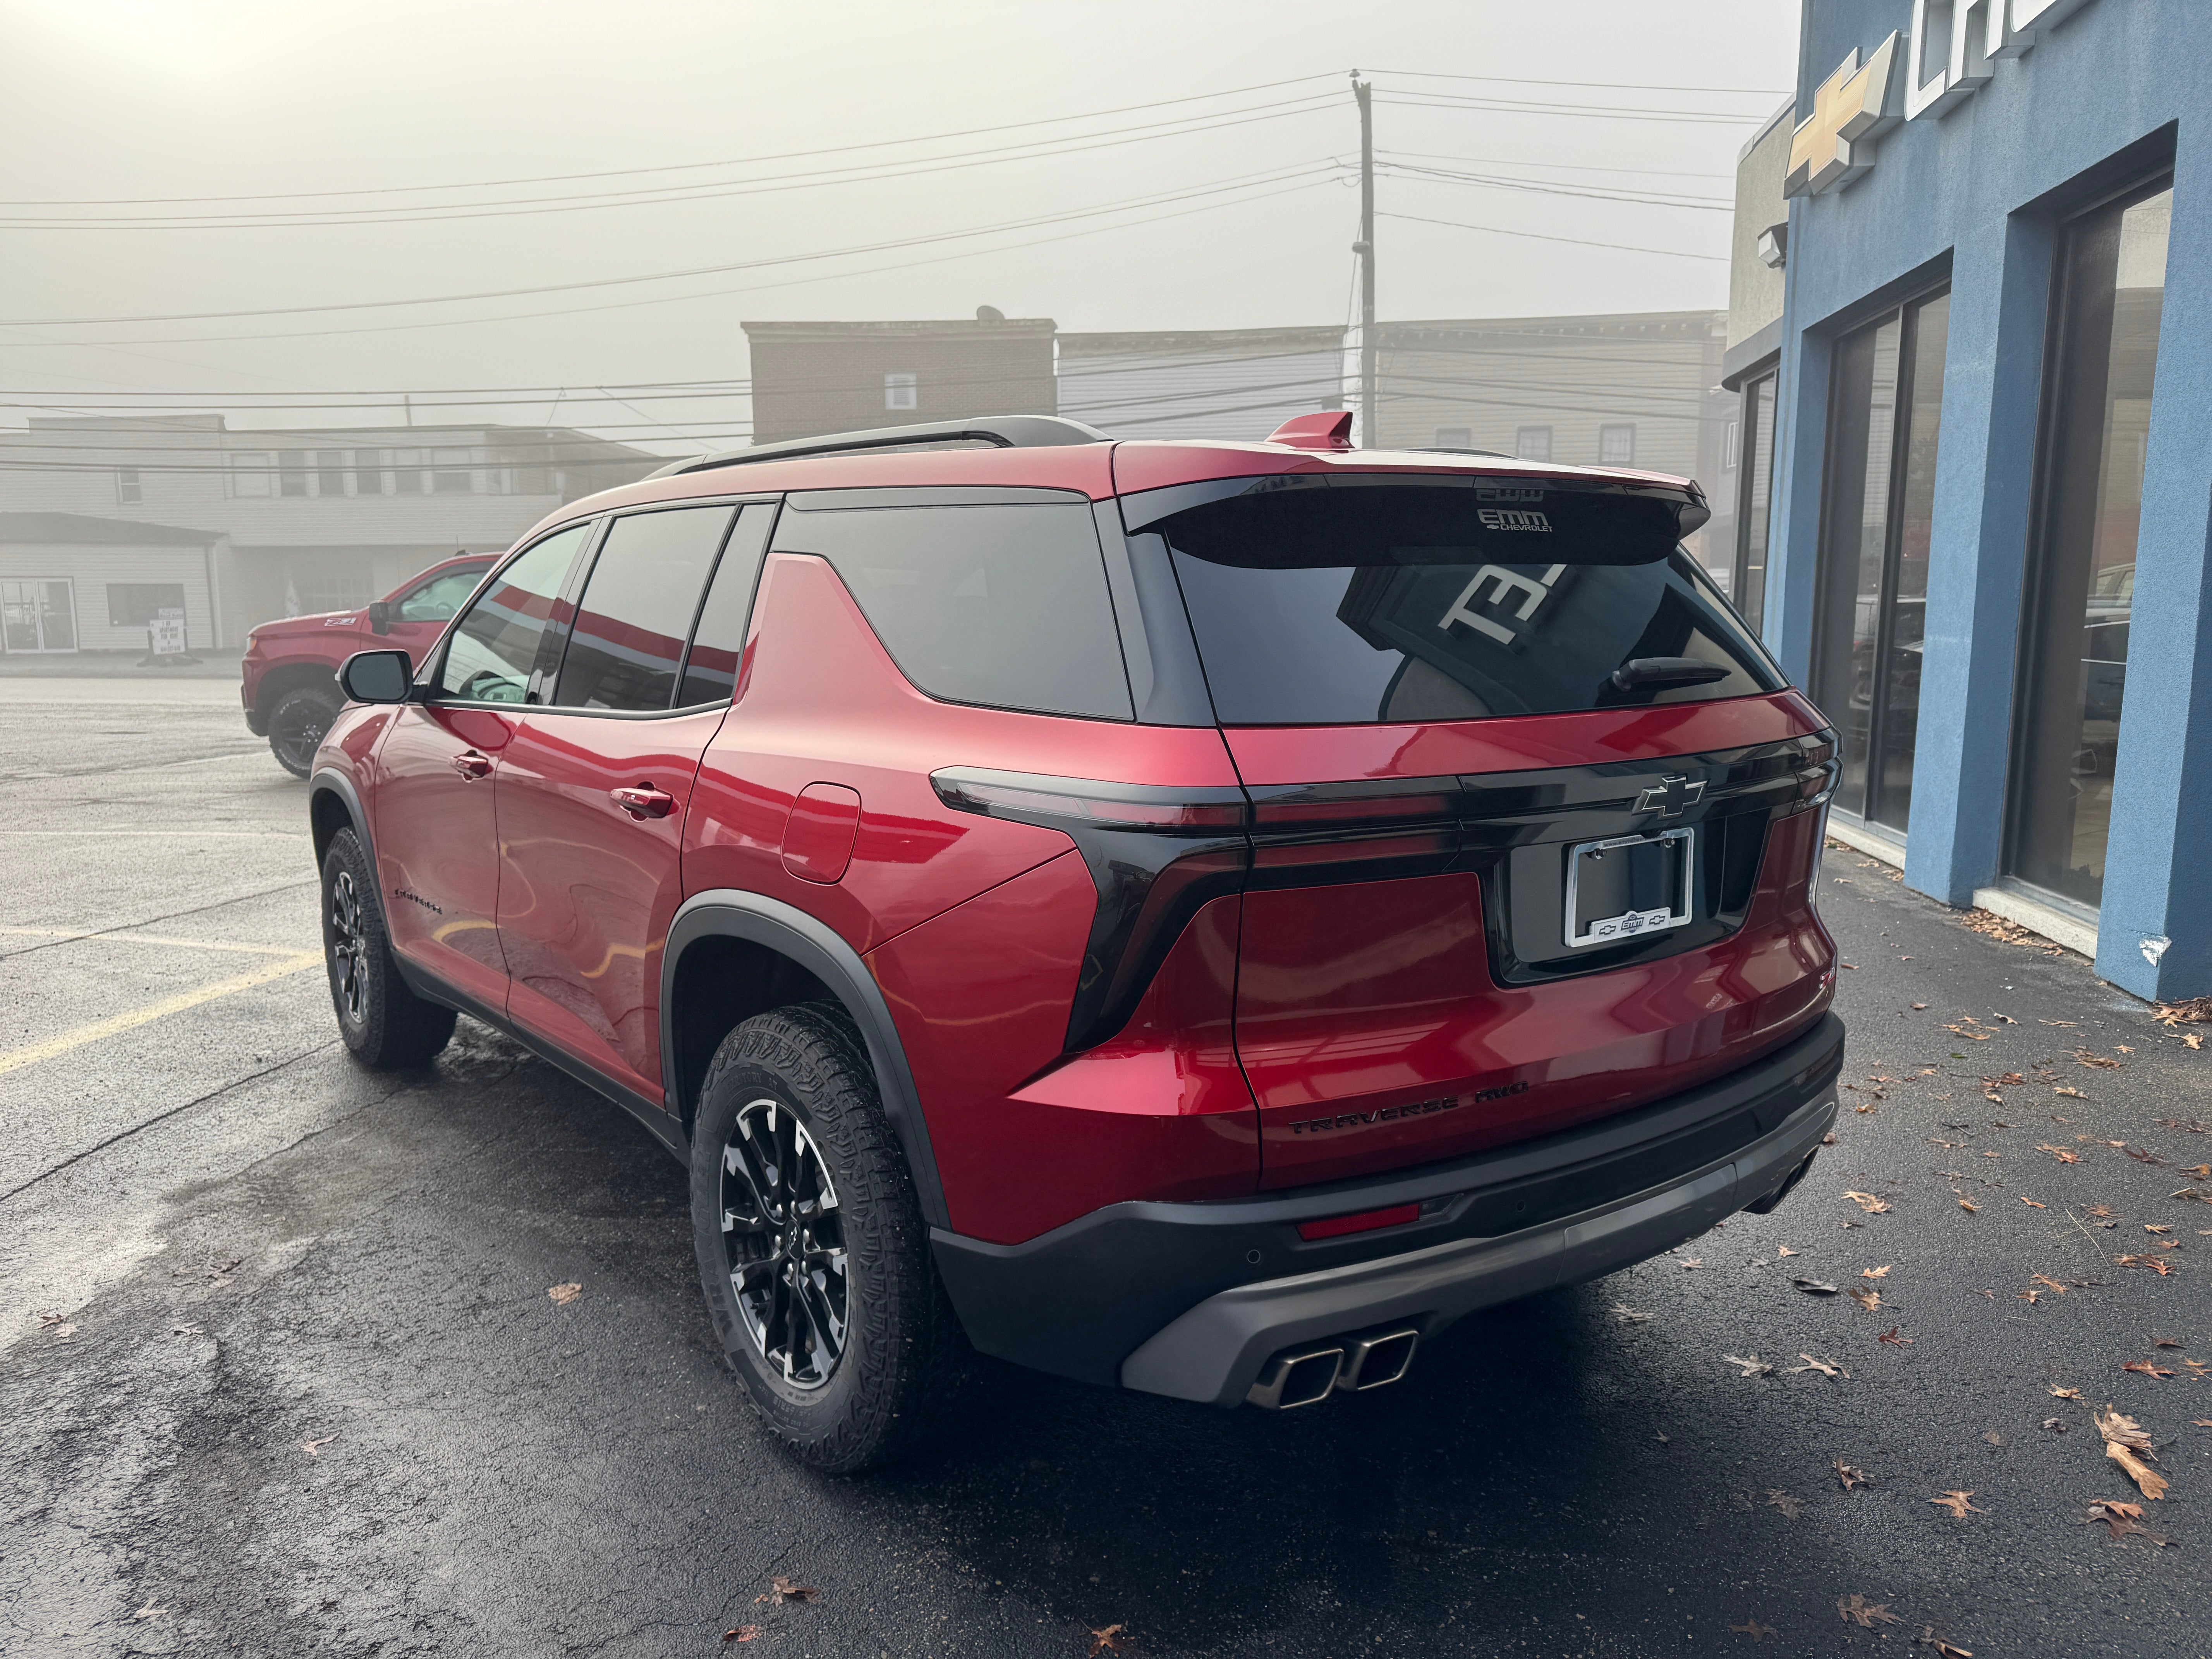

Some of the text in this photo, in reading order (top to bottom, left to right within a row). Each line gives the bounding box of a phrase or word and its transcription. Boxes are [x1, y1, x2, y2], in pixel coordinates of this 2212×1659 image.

[1500, 524, 1553, 532] CHEVROLET
[1288, 1081, 1529, 1134] TRAVERSE AWD
